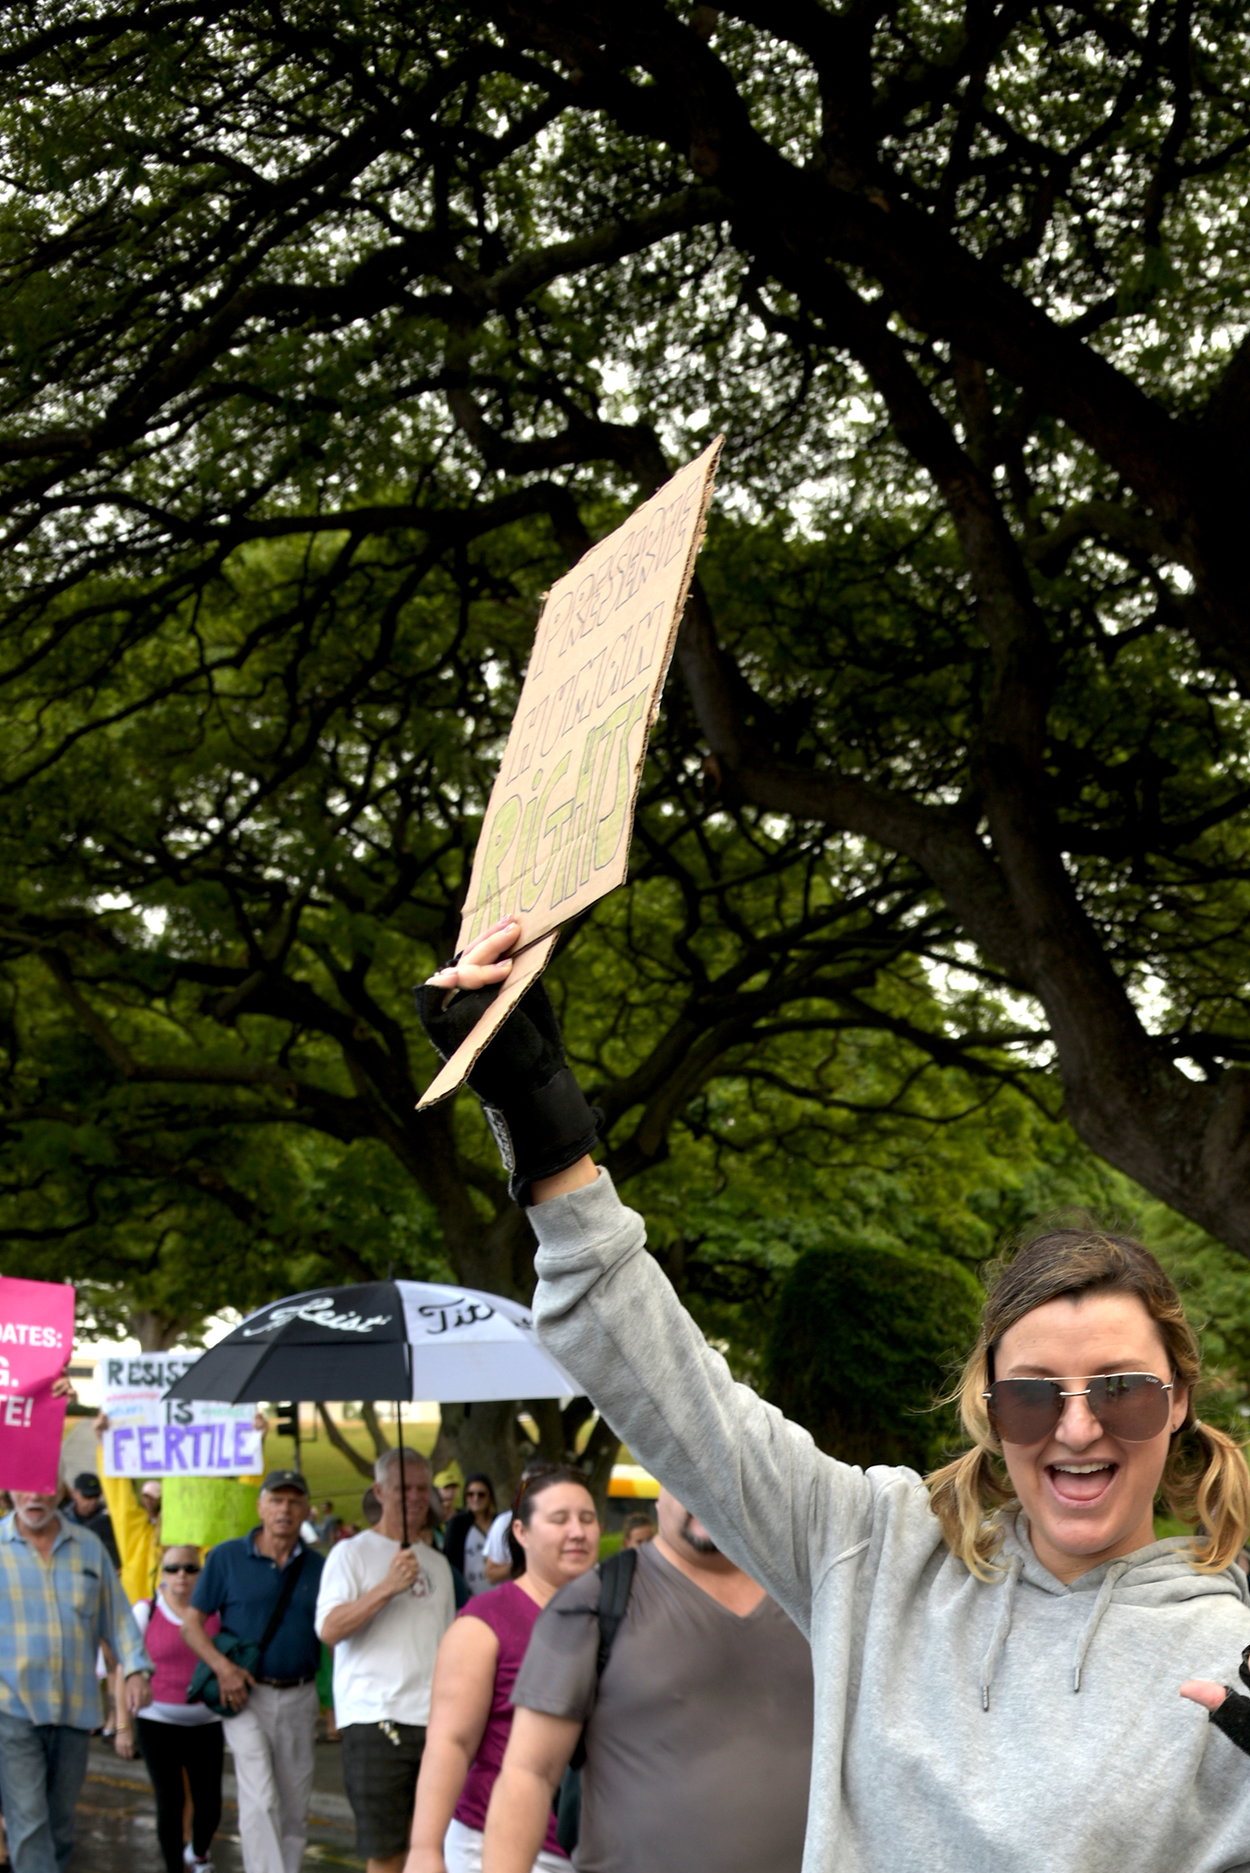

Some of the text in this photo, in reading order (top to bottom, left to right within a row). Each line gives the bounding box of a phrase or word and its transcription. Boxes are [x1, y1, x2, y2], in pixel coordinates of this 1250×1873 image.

[532, 475, 701, 681] PRESERVE
[0, 1322, 62, 1349] ATES:
[166, 1399, 194, 1425] IS
[112, 1421, 255, 1472] FERTILE
